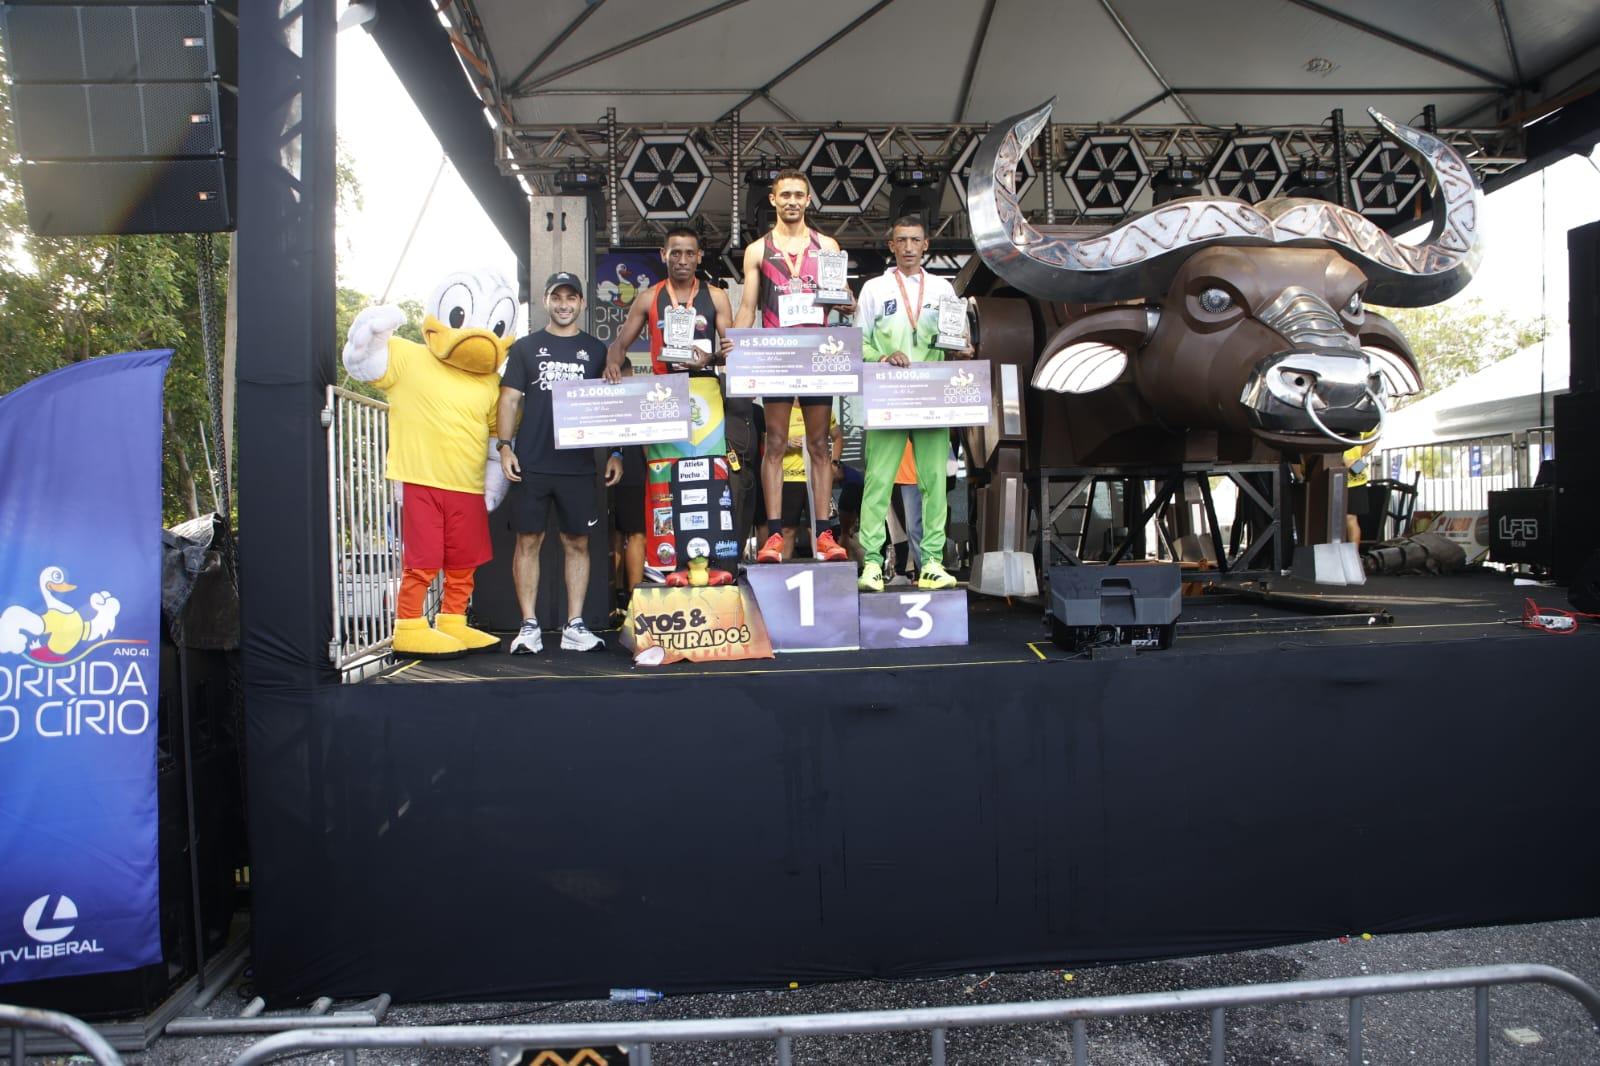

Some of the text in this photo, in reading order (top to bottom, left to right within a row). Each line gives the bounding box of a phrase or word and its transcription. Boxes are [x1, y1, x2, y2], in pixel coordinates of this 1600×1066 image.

[752, 337, 799, 347] 5.000,00
[811, 355, 850, 364] CORRIDA
[887, 371, 930, 380] 1.000,00
[579, 387, 626, 398] 2.000,00
[639, 401, 680, 412] CORRIDA
[785, 570, 815, 627] 1
[690, 608, 707, 628] &
[898, 594, 934, 639] 3
[113, 648, 149, 657] ANO 41
[35, 697, 149, 737] CÍRIO
